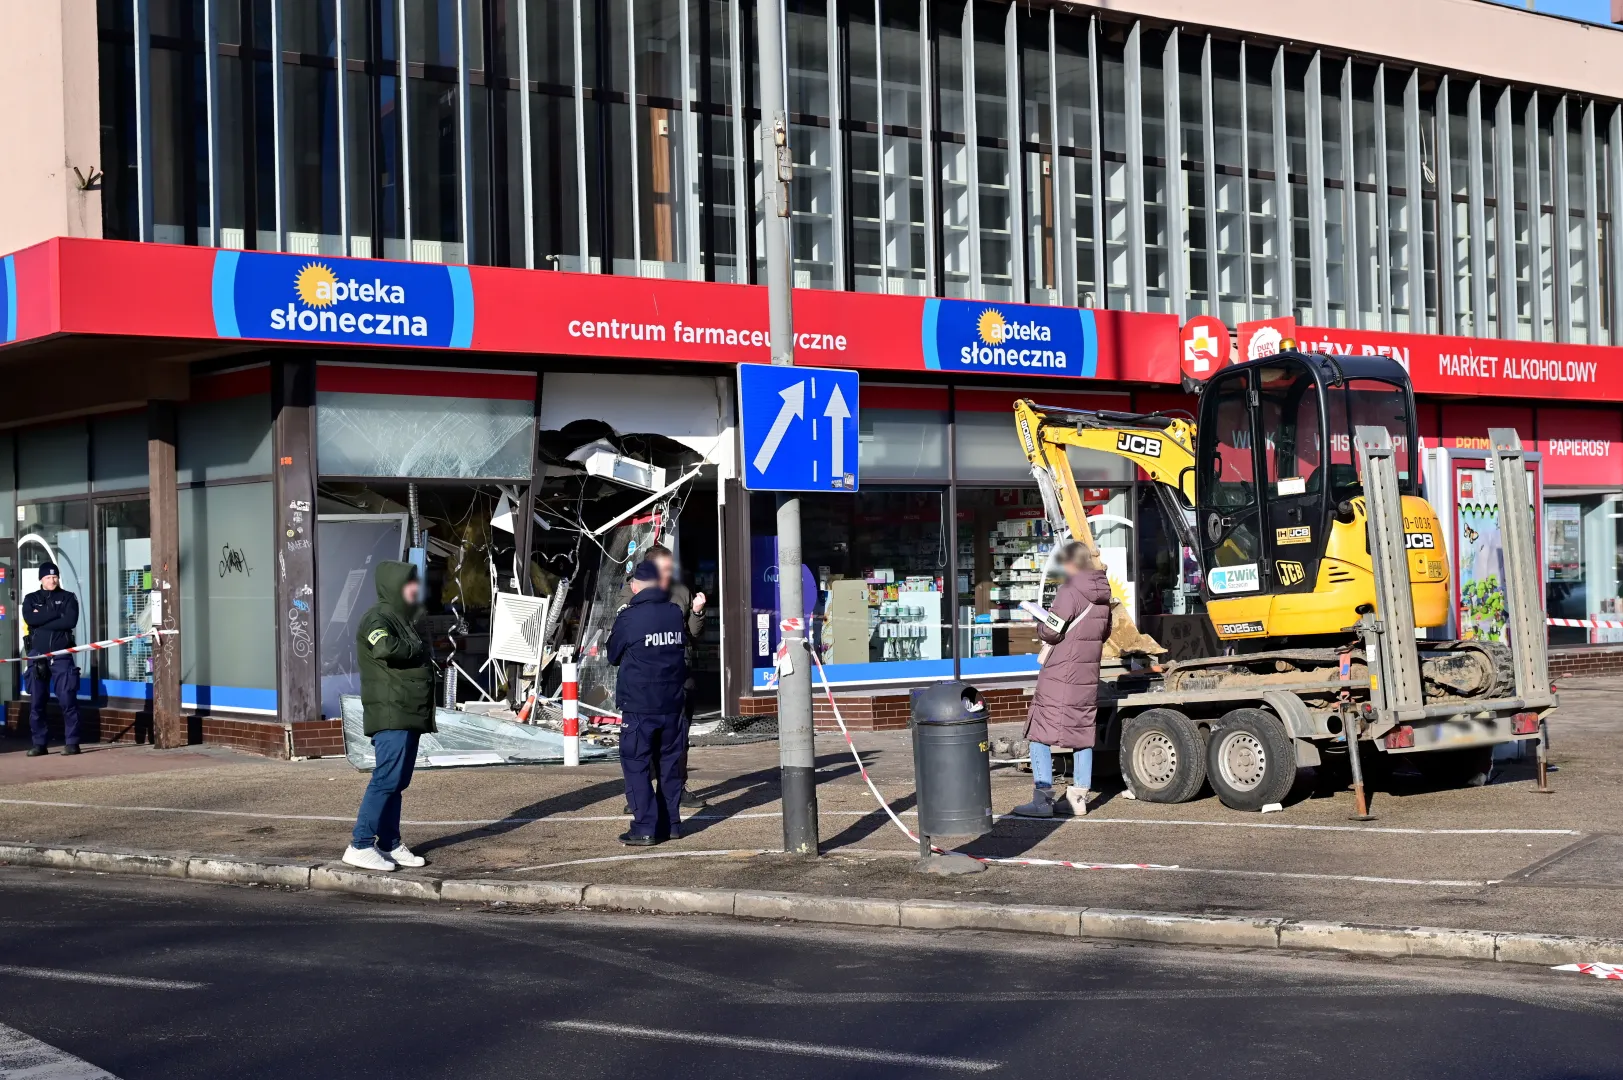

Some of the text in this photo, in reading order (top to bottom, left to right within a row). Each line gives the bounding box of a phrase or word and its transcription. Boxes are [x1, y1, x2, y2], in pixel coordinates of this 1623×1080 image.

[316, 279, 405, 305] apteka
[270, 303, 428, 336] słoneczna
[568, 318, 666, 342] centrum
[991, 321, 1051, 343] apteka
[961, 341, 1067, 368] słoneczna
[1439, 353, 1498, 378] MARKET
[1503, 357, 1598, 382] ALKOHOLOWY
[1118, 434, 1161, 456] JCB
[1549, 438, 1610, 457] PAPIEROSY
[1289, 528, 1309, 537] JCB
[1404, 533, 1434, 549] JCB
[1227, 568, 1257, 582] ZWiK
[1280, 563, 1303, 587] JCB
[644, 631, 683, 647] POLICJA
